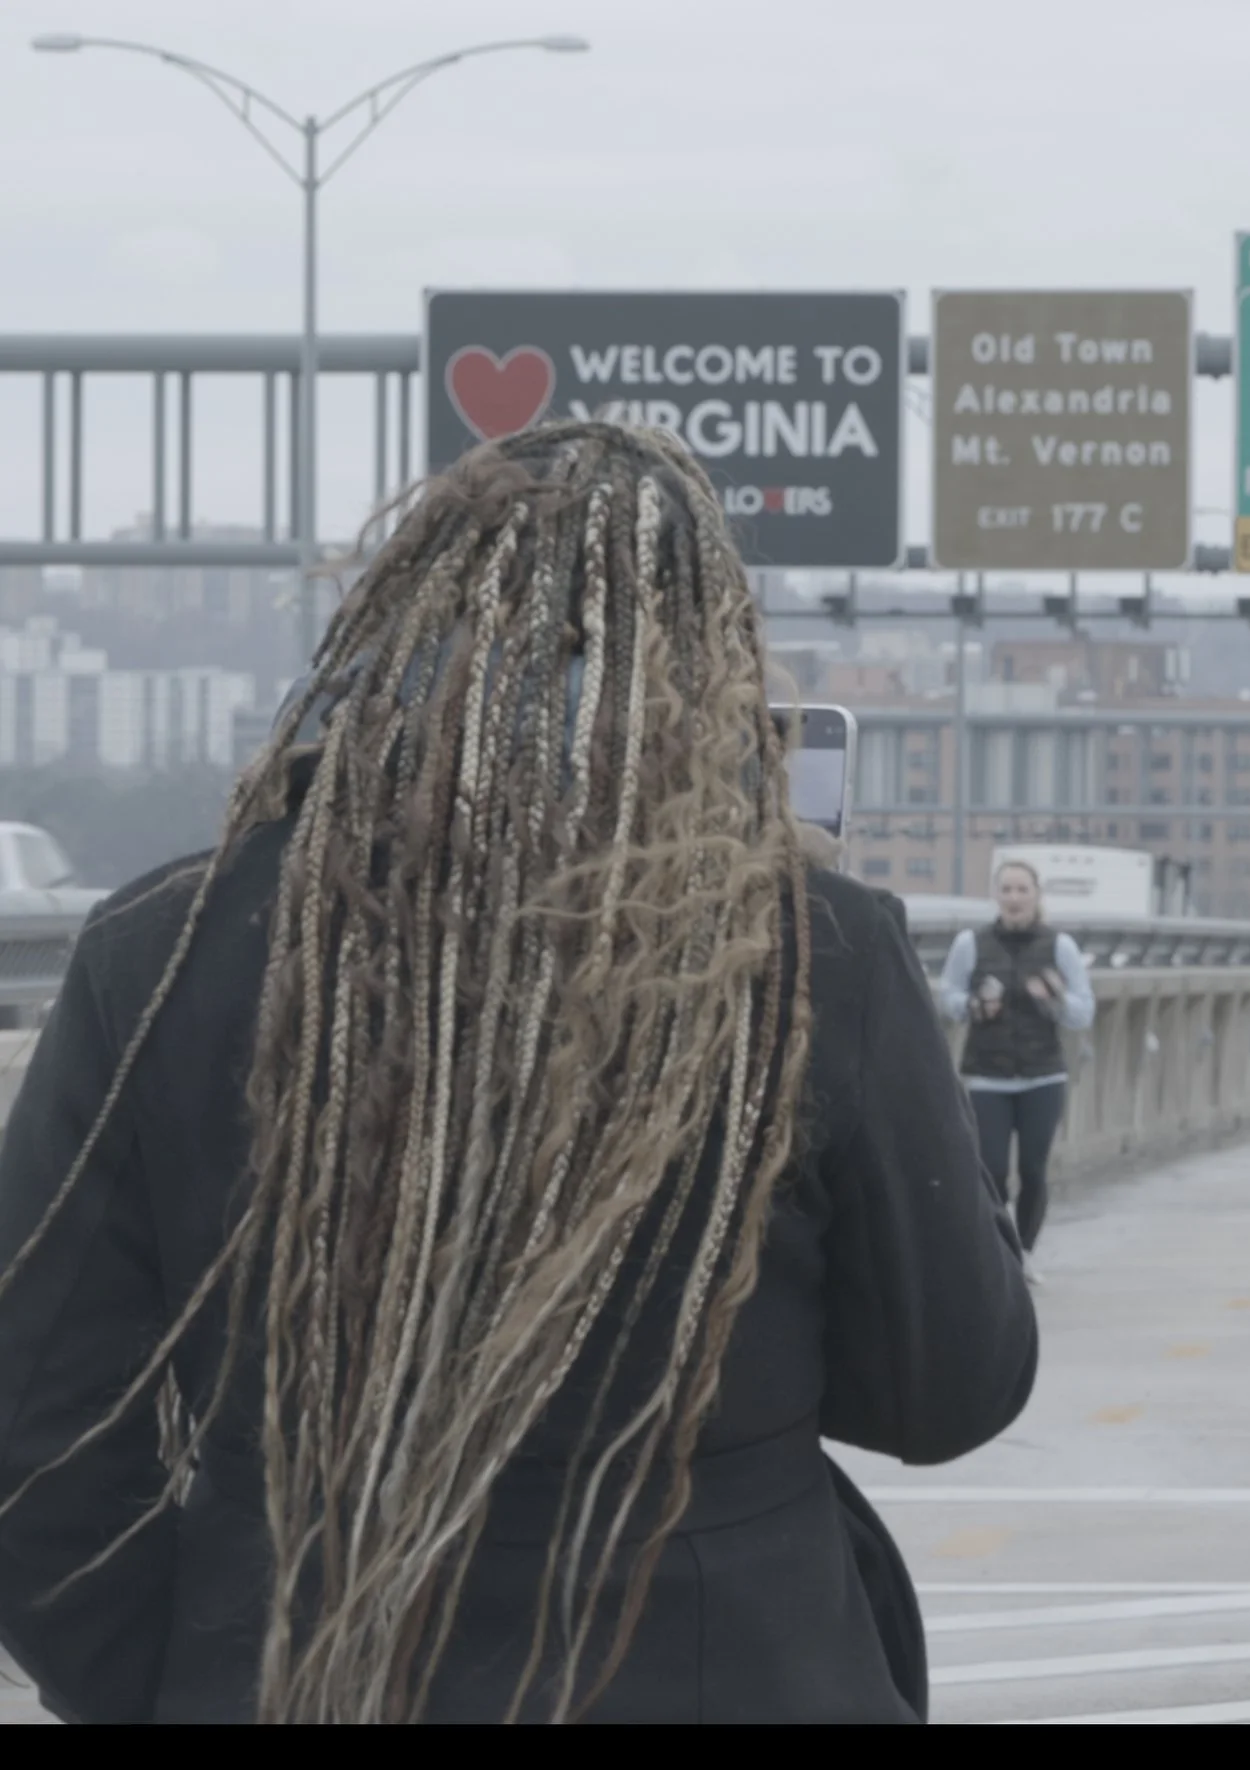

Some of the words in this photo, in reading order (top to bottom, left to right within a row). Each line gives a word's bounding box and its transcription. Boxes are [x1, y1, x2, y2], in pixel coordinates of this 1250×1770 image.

[971, 332, 1035, 364] Old
[1055, 332, 1153, 363] Town
[570, 345, 796, 385] WELCOME
[813, 345, 882, 385] TO
[954, 384, 1171, 415] Alexandria
[952, 435, 1008, 465] Mt.
[1032, 435, 1171, 466] Vernon
[977, 506, 1031, 529] EXIT
[1052, 502, 1107, 533] 177
[1119, 502, 1143, 533] C
